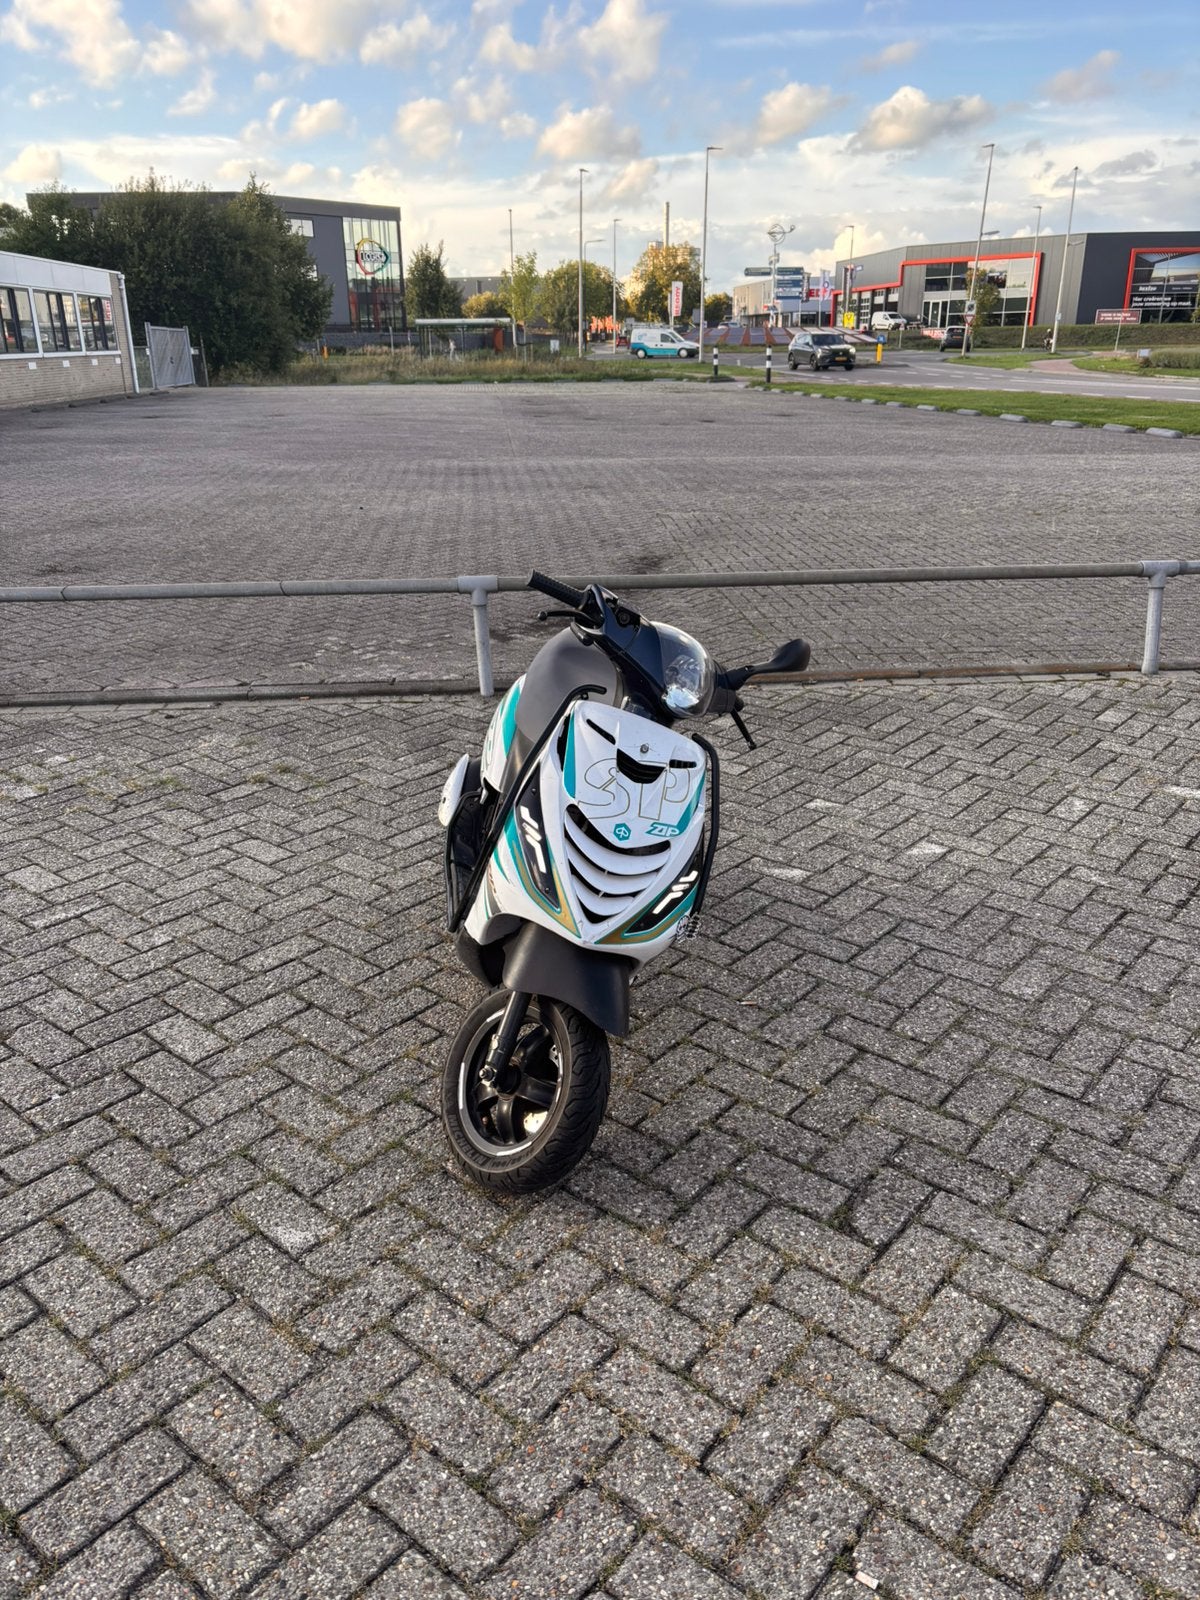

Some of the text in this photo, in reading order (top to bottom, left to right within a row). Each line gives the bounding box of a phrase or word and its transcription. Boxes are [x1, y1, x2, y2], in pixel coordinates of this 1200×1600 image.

[578, 757, 691, 821] SP
[648, 823, 681, 837] ZIP
[447, 1114, 487, 1165] MICHELIN
